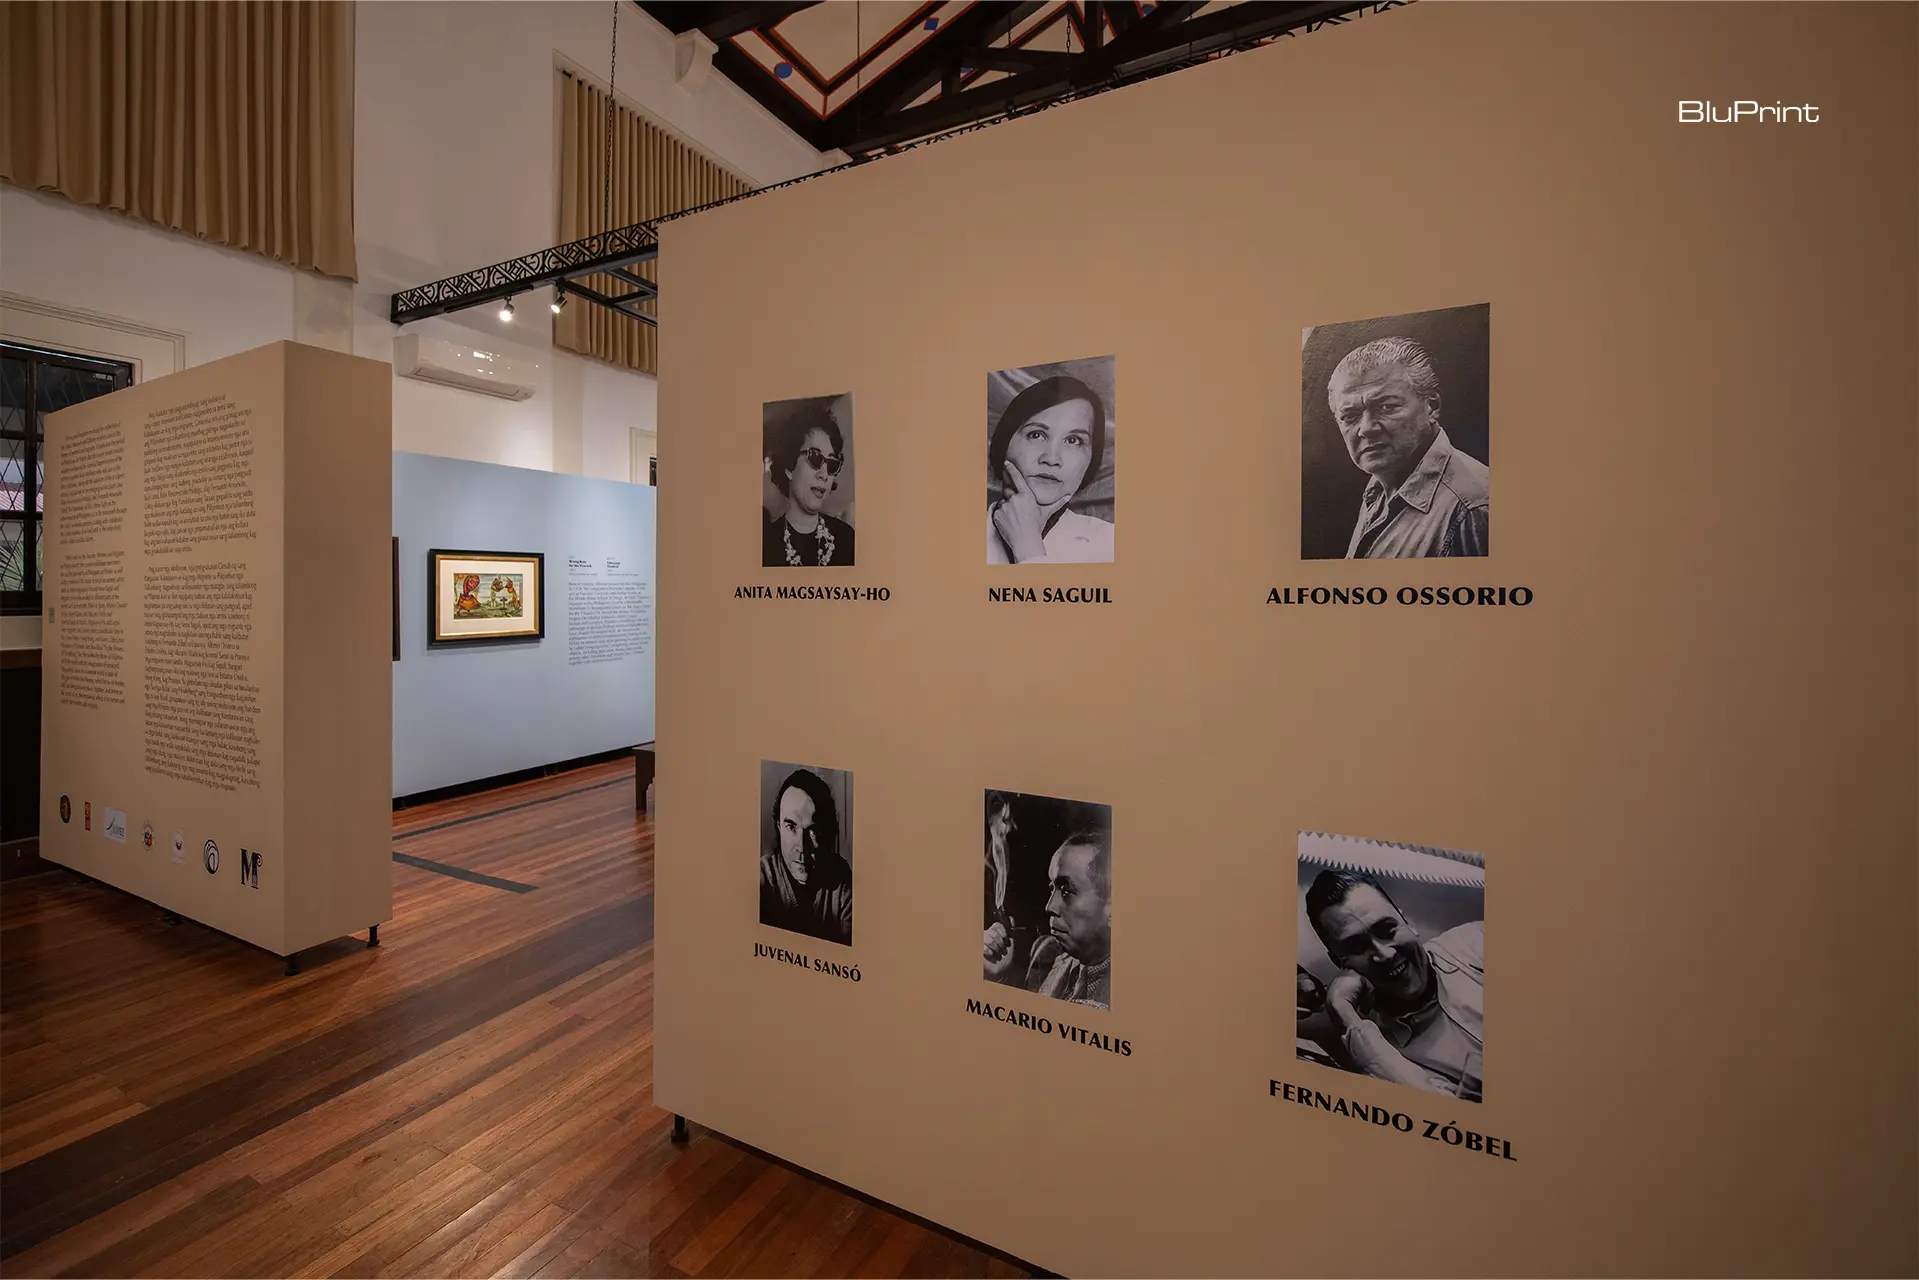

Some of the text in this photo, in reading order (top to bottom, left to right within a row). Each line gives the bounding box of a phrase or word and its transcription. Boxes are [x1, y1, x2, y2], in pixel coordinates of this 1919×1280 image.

[733, 586, 891, 602] ANITA MAGSAYSAY-HO
[988, 587, 1113, 604] NENA SAGUIL
[1266, 586, 1534, 607] ALFONSO OSSORIO
[753, 942, 862, 982] JUVENAL SANSÓ
[965, 998, 1053, 1034] MACARIO
[1056, 1022, 1132, 1057] VITALIS
[1269, 1079, 1518, 1163] FERNANDO ZÓBEL
